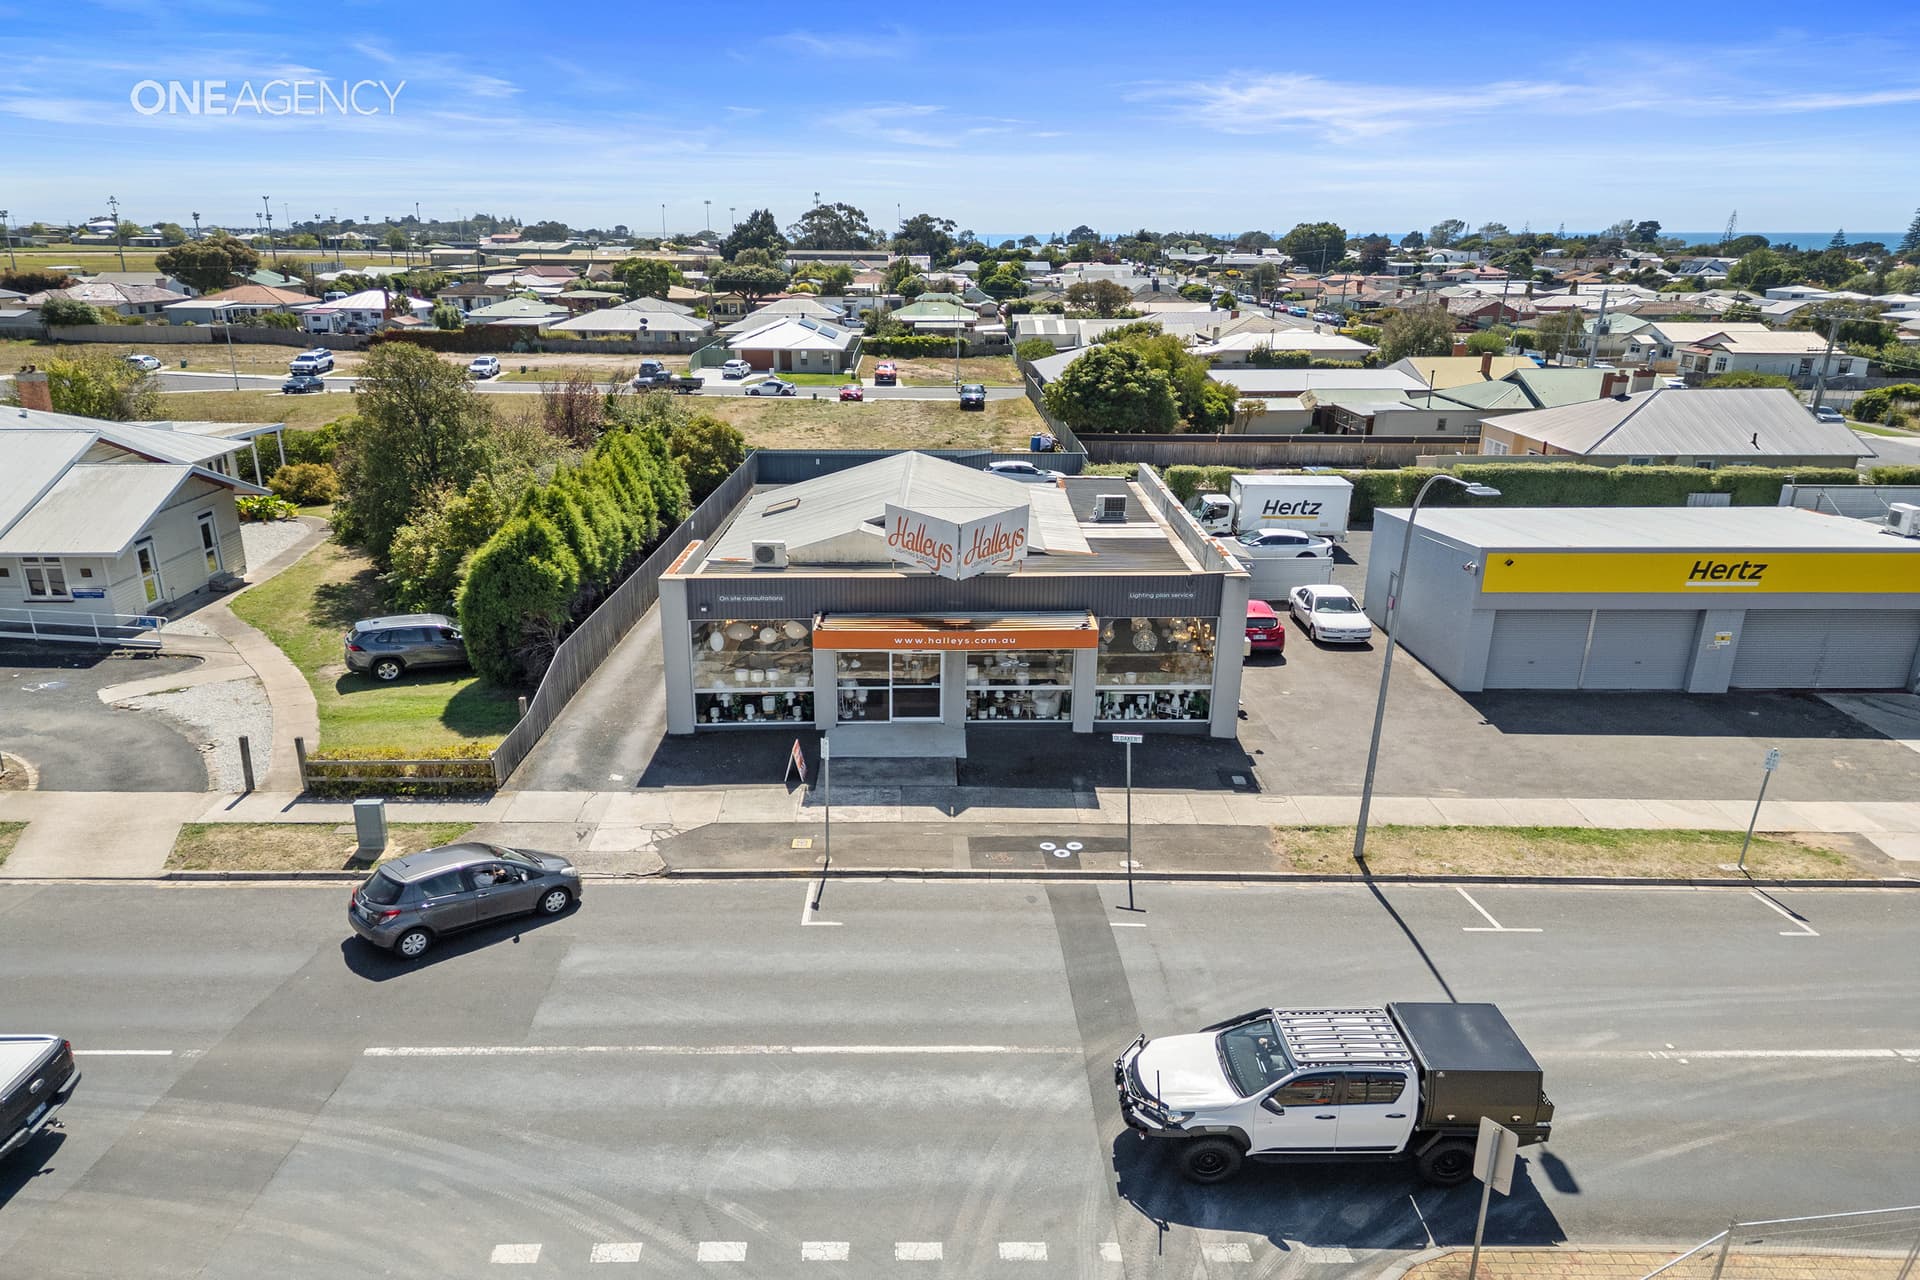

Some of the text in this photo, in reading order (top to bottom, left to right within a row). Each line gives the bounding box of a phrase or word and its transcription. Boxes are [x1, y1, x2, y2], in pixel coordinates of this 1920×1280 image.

[1262, 500, 1322, 515] Hertz
[888, 516, 952, 571] Halleys
[964, 522, 1024, 566] Halleys
[1688, 561, 1768, 579] Hertz
[894, 637, 1016, 646] www.halleys.com.au
